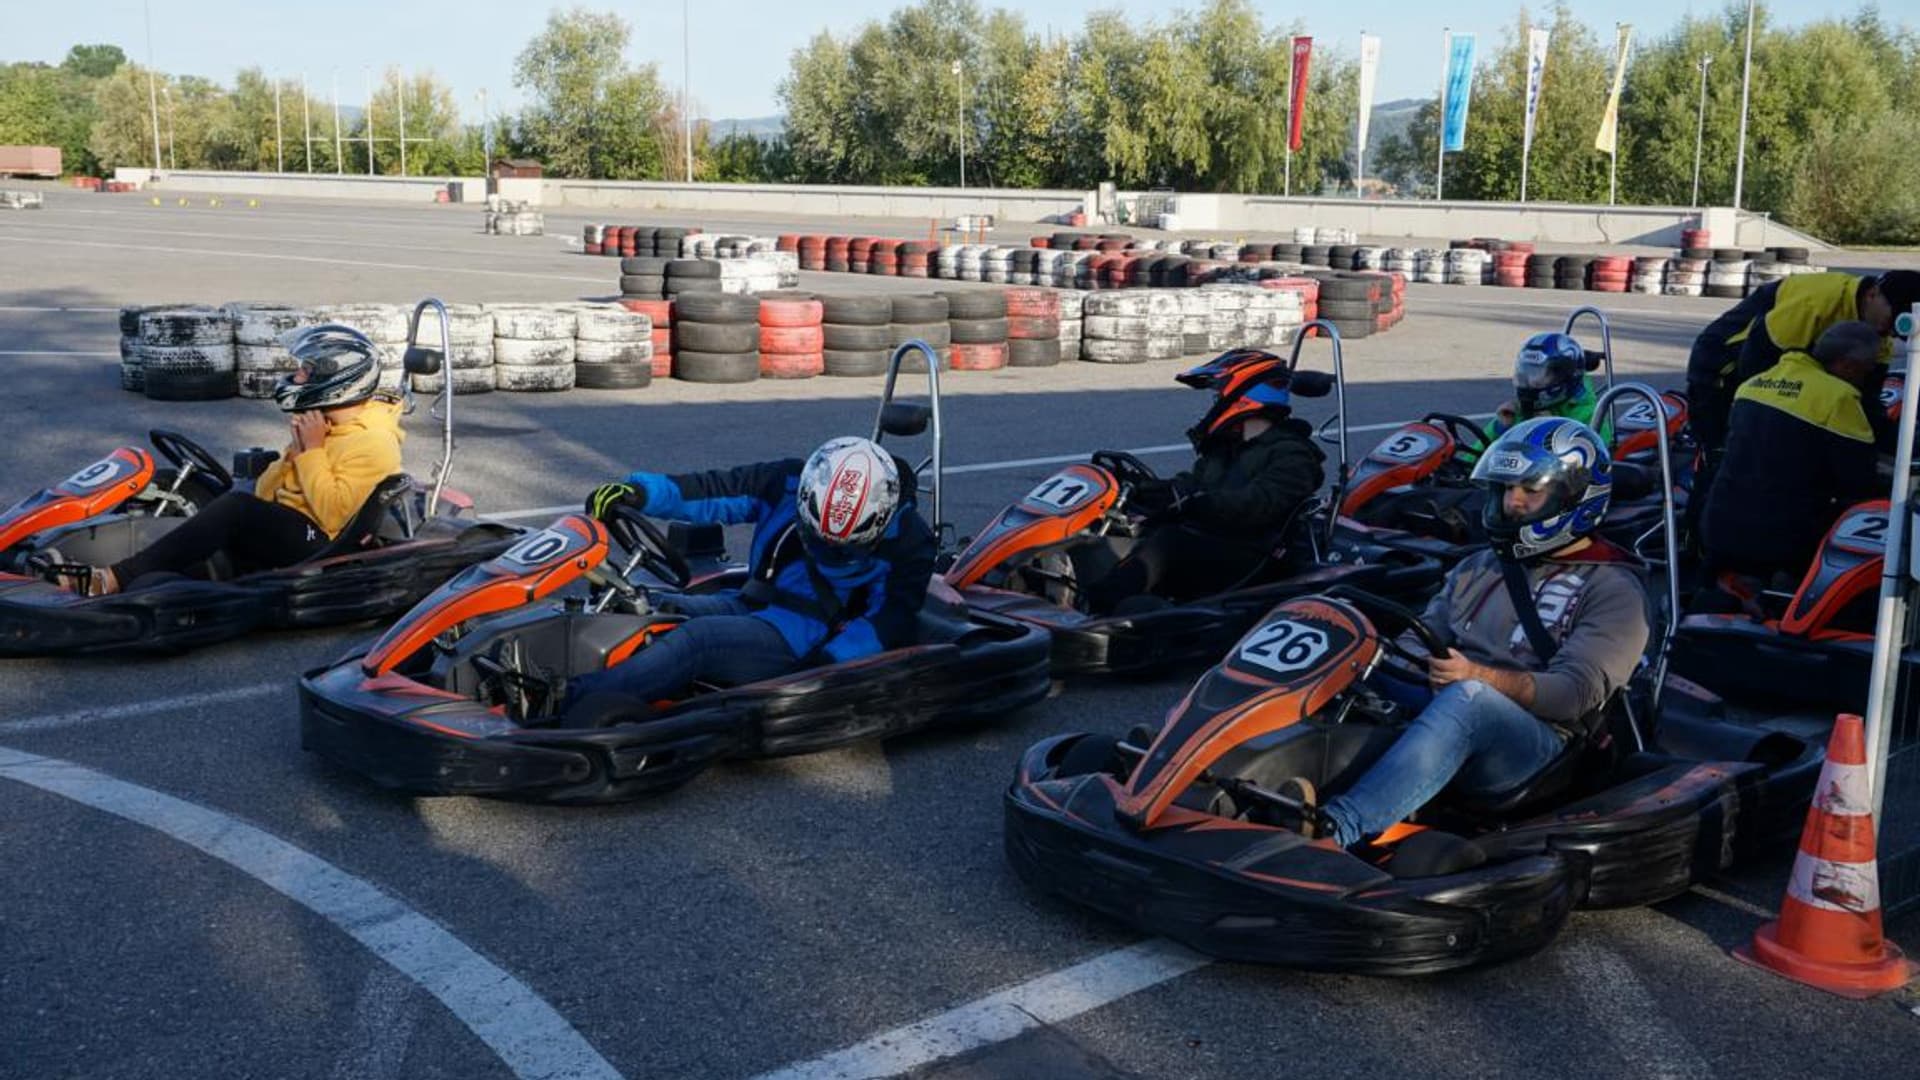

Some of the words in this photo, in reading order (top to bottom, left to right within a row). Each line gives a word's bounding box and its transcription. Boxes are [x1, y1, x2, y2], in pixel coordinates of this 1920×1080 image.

[1389, 436, 1417, 453] 5
[77, 463, 109, 481] 9
[1037, 478, 1084, 505] 11
[508, 532, 562, 561] 10
[1245, 623, 1322, 665] 26
